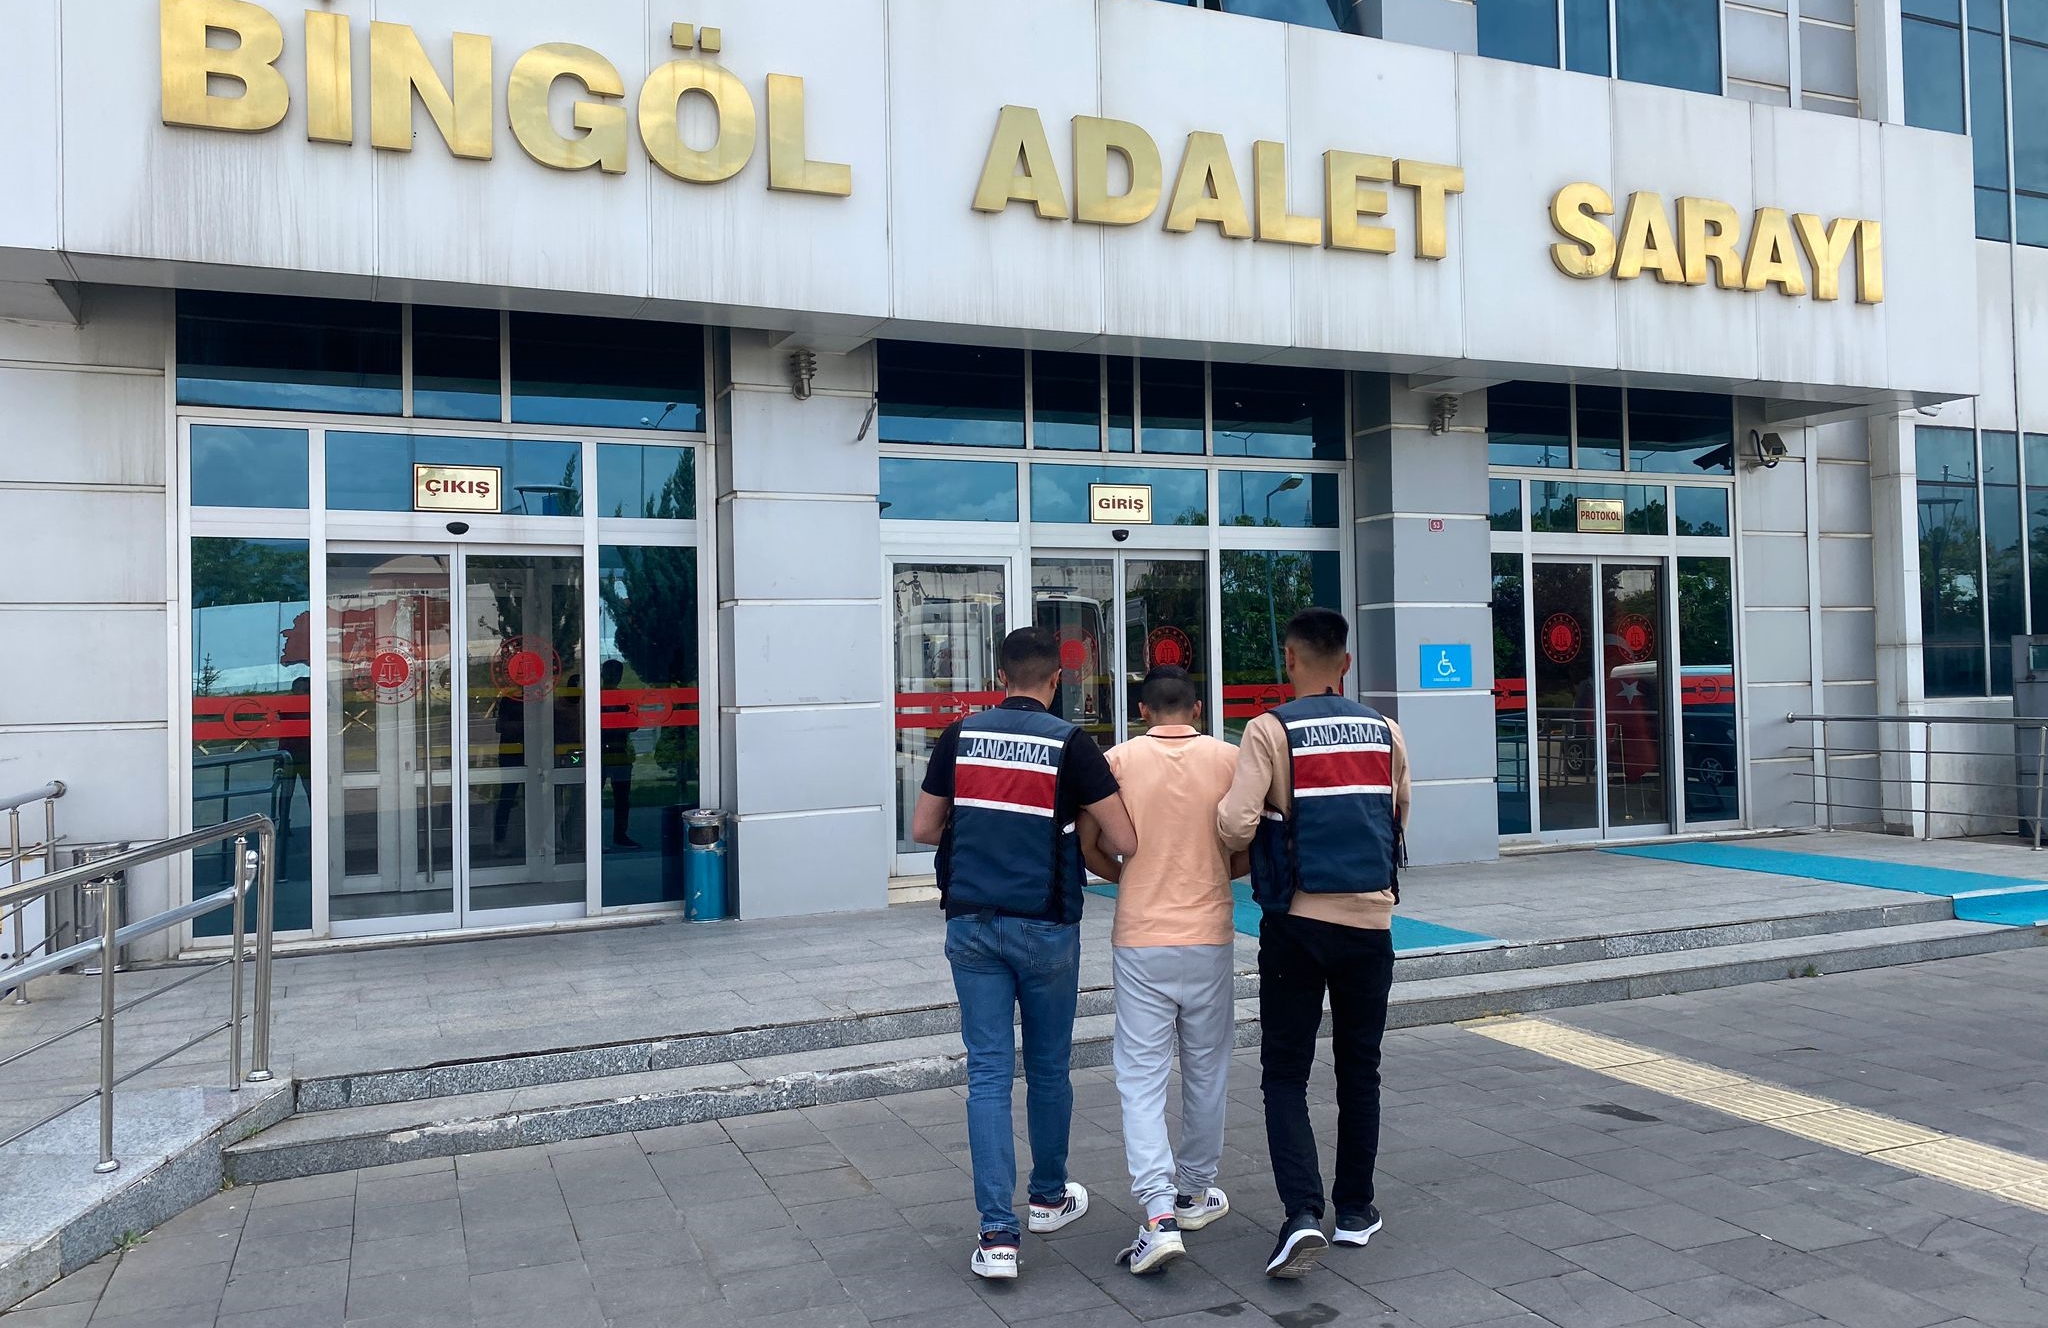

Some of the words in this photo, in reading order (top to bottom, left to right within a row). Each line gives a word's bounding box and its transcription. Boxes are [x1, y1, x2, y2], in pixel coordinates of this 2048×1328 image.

[160, 0, 851, 197] BİNGÖL
[971, 104, 1465, 261] ADALET
[1548, 181, 1883, 304] SARAYI
[425, 479, 490, 498] ÇIKIŞ
[1098, 495, 1144, 513] GİRİŞ
[1580, 510, 1621, 521] PROTOKOL
[1302, 723, 1384, 747] JANDARMA
[966, 738, 1050, 766] JANDARMA
[1030, 1210, 1049, 1218] didas
